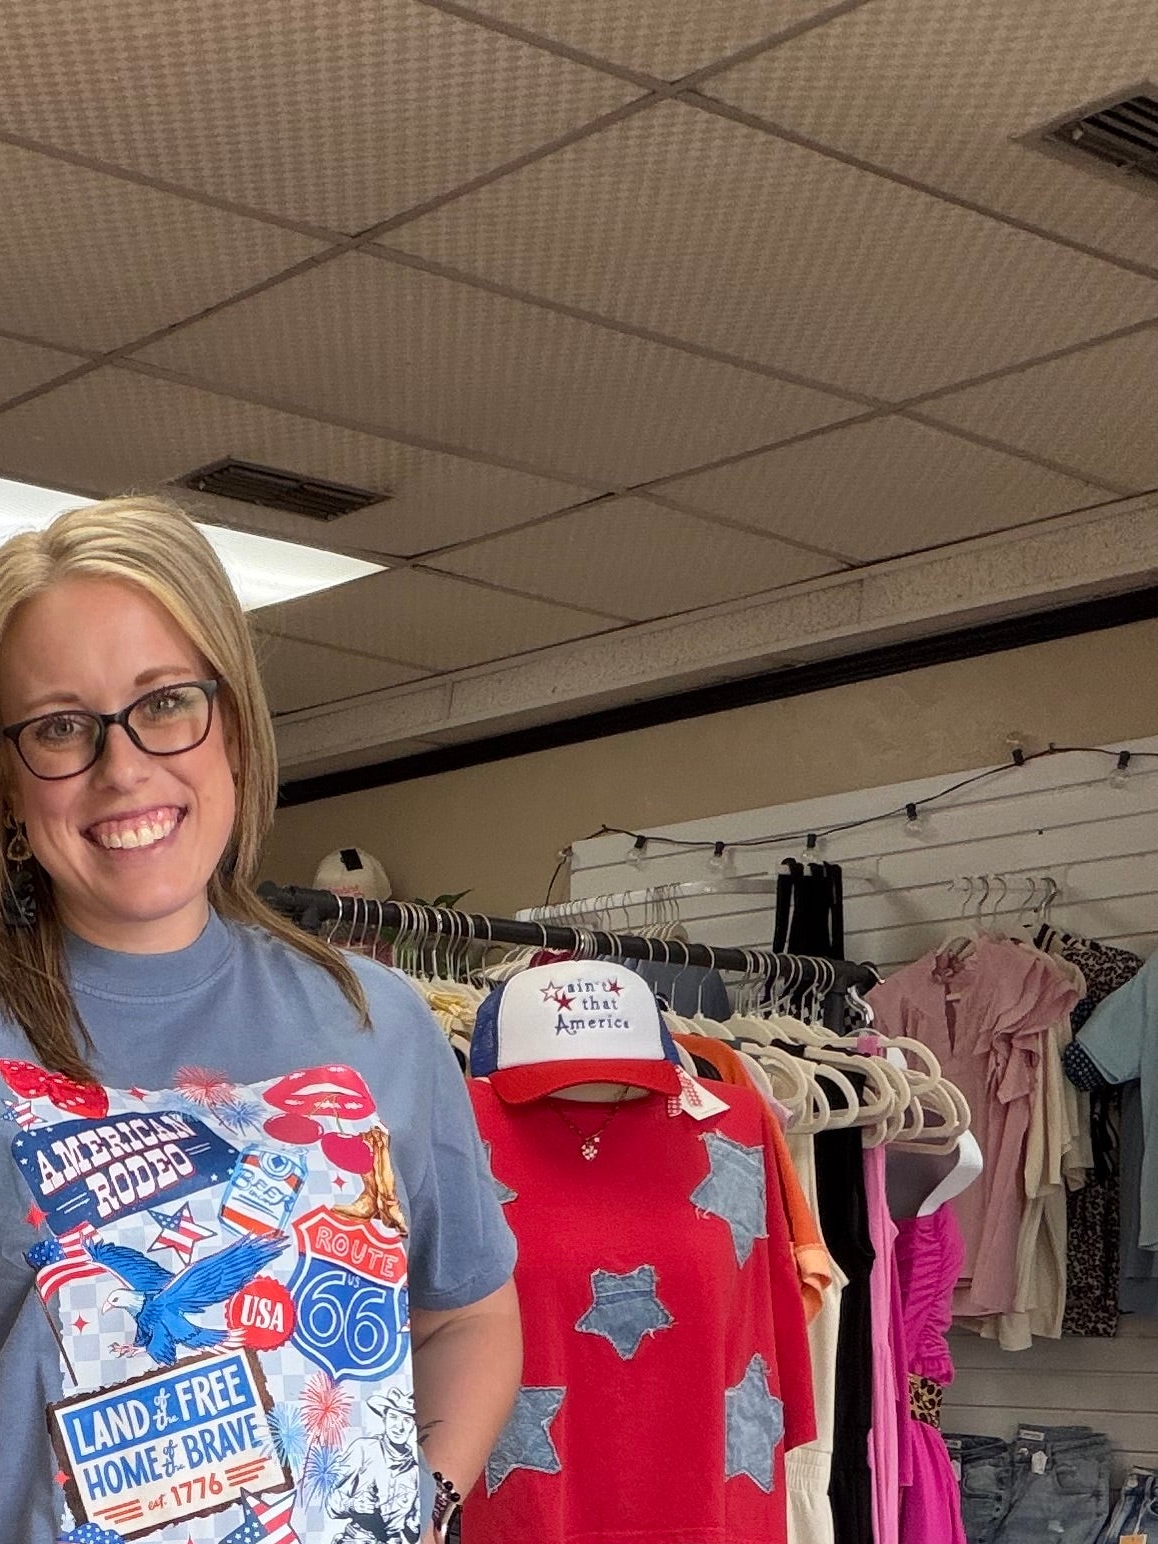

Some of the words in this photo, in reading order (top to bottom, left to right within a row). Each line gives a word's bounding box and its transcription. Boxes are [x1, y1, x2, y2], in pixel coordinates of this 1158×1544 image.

[582, 996, 618, 1011] that
[40, 1114, 198, 1196] AMERICAN
[85, 1143, 194, 1218] RODEO
[316, 1226, 399, 1278] ROUTE
[347, 1273, 360, 1288] US
[240, 1293, 285, 1333] USA
[298, 1270, 390, 1365] 66
[72, 1399, 150, 1457] LAND
[152, 1407, 179, 1431] the
[175, 1364, 246, 1422] FREE
[83, 1445, 162, 1500] HOME
[161, 1459, 186, 1478] the
[180, 1412, 263, 1470] BRAVE
[170, 1472, 224, 1507] 1776
